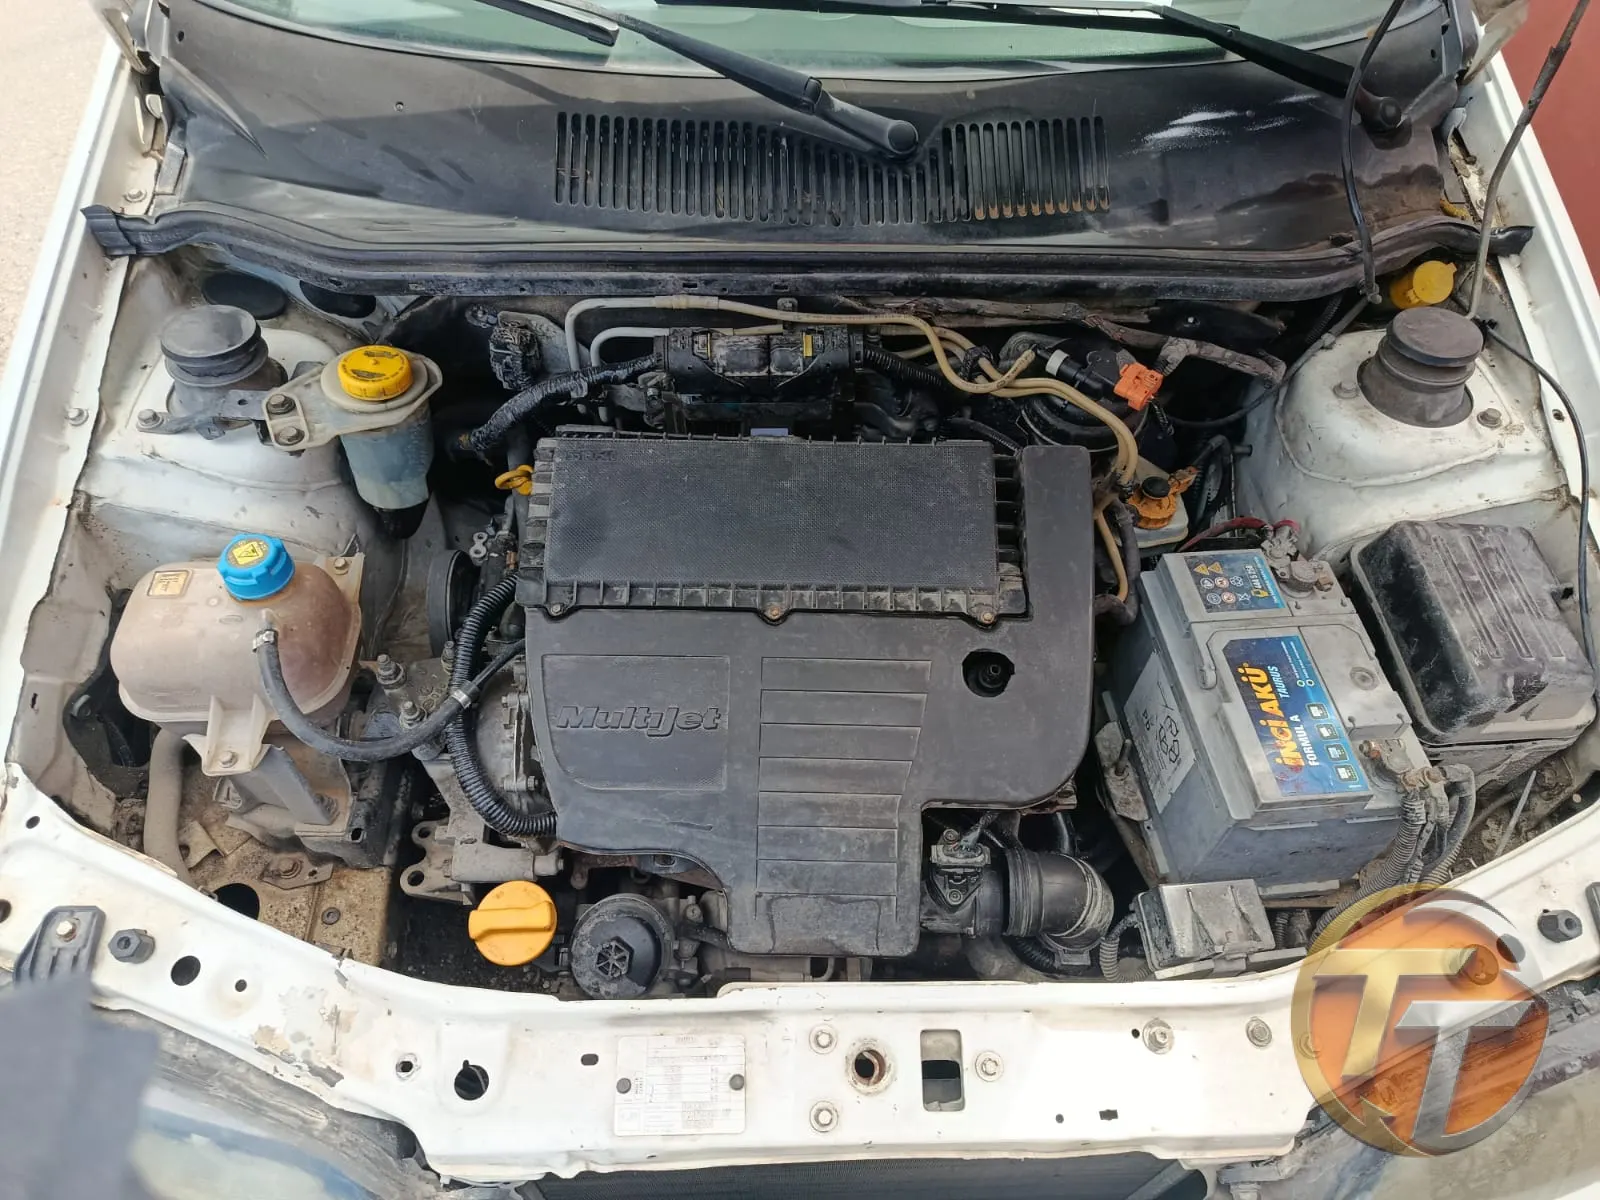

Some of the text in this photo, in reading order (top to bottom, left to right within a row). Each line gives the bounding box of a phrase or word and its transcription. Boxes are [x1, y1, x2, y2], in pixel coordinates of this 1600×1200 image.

[1237, 667, 1284, 718] AKÜ
[1267, 665, 1290, 698] TAURUS
[1259, 719, 1305, 766] İNCİ
[1289, 714, 1320, 766] FORMUL A
